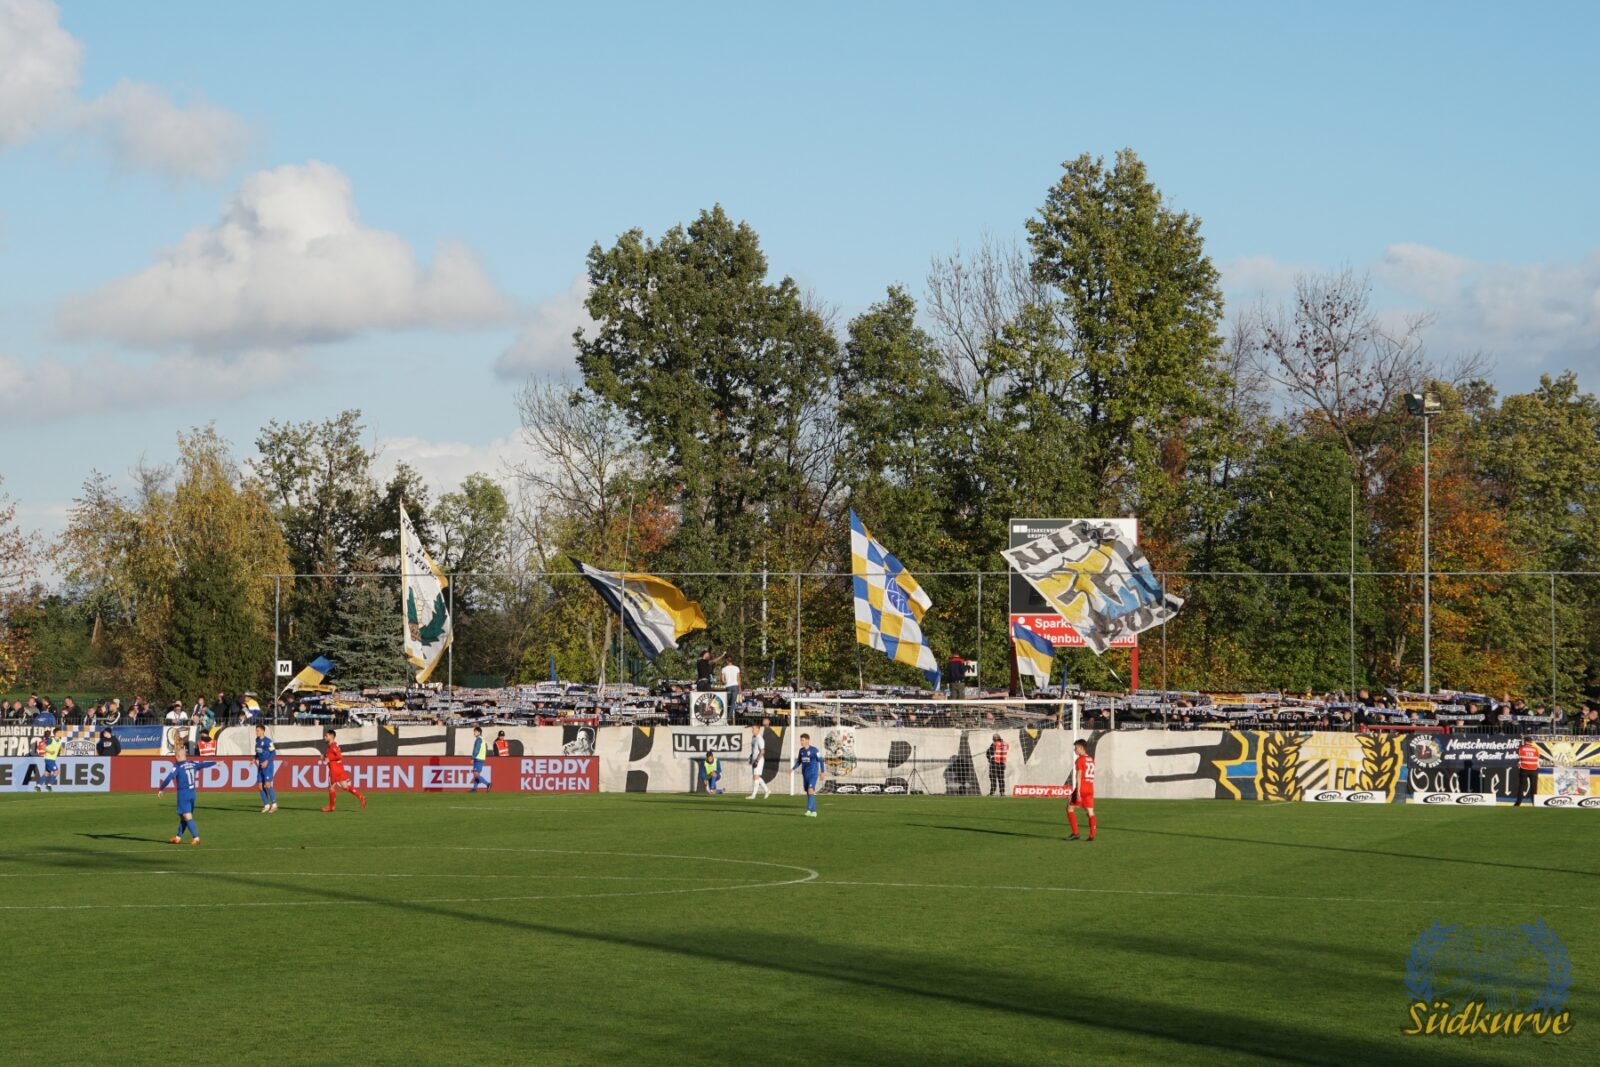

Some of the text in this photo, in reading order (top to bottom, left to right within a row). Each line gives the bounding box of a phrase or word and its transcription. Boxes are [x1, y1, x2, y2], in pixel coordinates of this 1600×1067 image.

[1039, 633, 1135, 645] ltenbur and
[279, 663, 290, 673] M
[674, 735, 741, 751] ULTRAS
[1446, 738, 1521, 751] Menschenrechte
[521, 759, 591, 774] REDDY
[1085, 762, 1095, 778] 22
[151, 761, 282, 788] RDD
[1335, 767, 1356, 790] FC
[521, 775, 590, 790] KÜCHEN
[1015, 787, 1050, 795] REDDY
